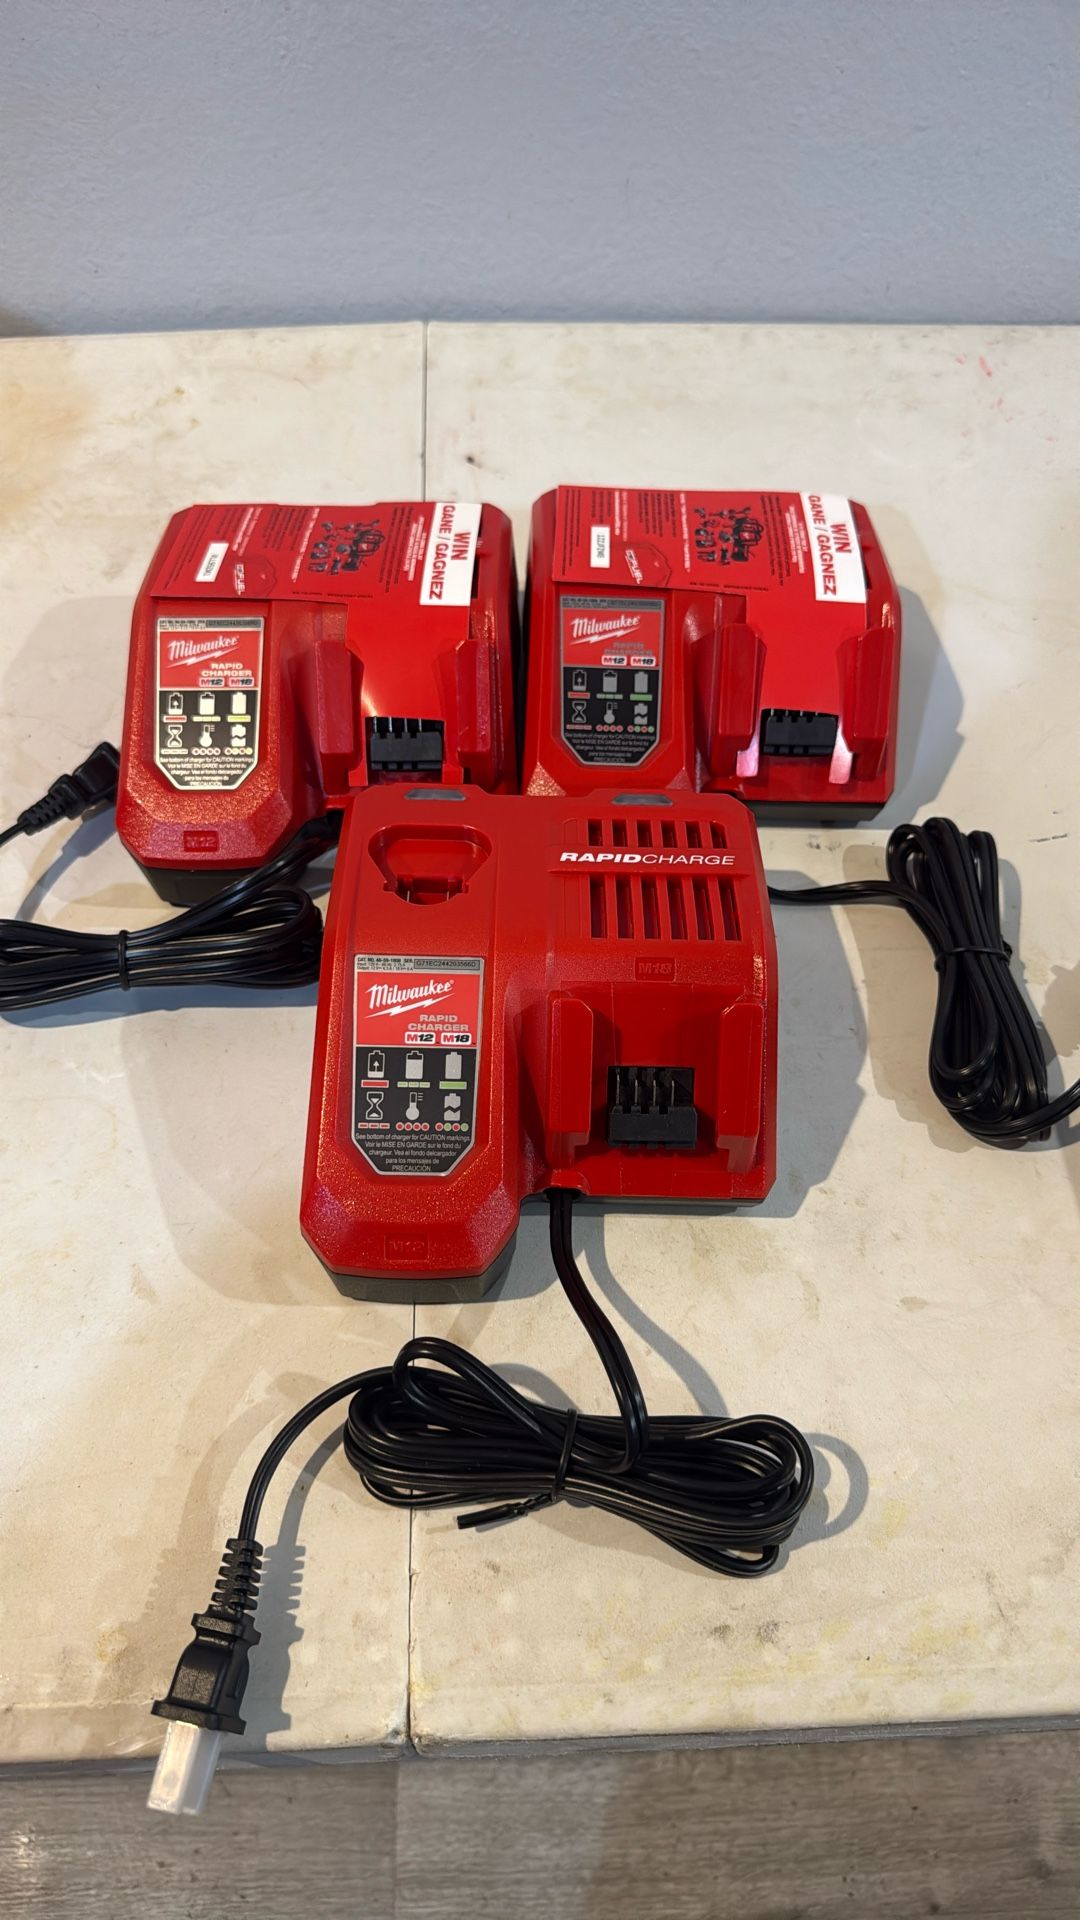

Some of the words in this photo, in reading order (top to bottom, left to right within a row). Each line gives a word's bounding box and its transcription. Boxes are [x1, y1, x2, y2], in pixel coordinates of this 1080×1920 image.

[439, 505, 455, 534] GANE
[808, 494, 827, 525] GANE
[451, 532, 471, 561] WIN
[829, 523, 852, 553] WIN
[429, 543, 449, 600] GAGNEZ
[817, 534, 837, 596] GAGNEZ
[570, 615, 640, 638] Milwaukee
[167, 636, 239, 661] Milwaukee
[603, 657, 626, 665] M12
[632, 658, 654, 666] M18
[200, 679, 224, 687] M12
[230, 679, 254, 687] M18
[560, 852, 736, 866] RAPIDCHARGE
[364, 980, 453, 1010] Milwaukee
[407, 1023, 469, 1032] CHARGER
[419, 1014, 458, 1022] RAPID
[406, 1033, 434, 1043] M12
[443, 1034, 470, 1044] M18
